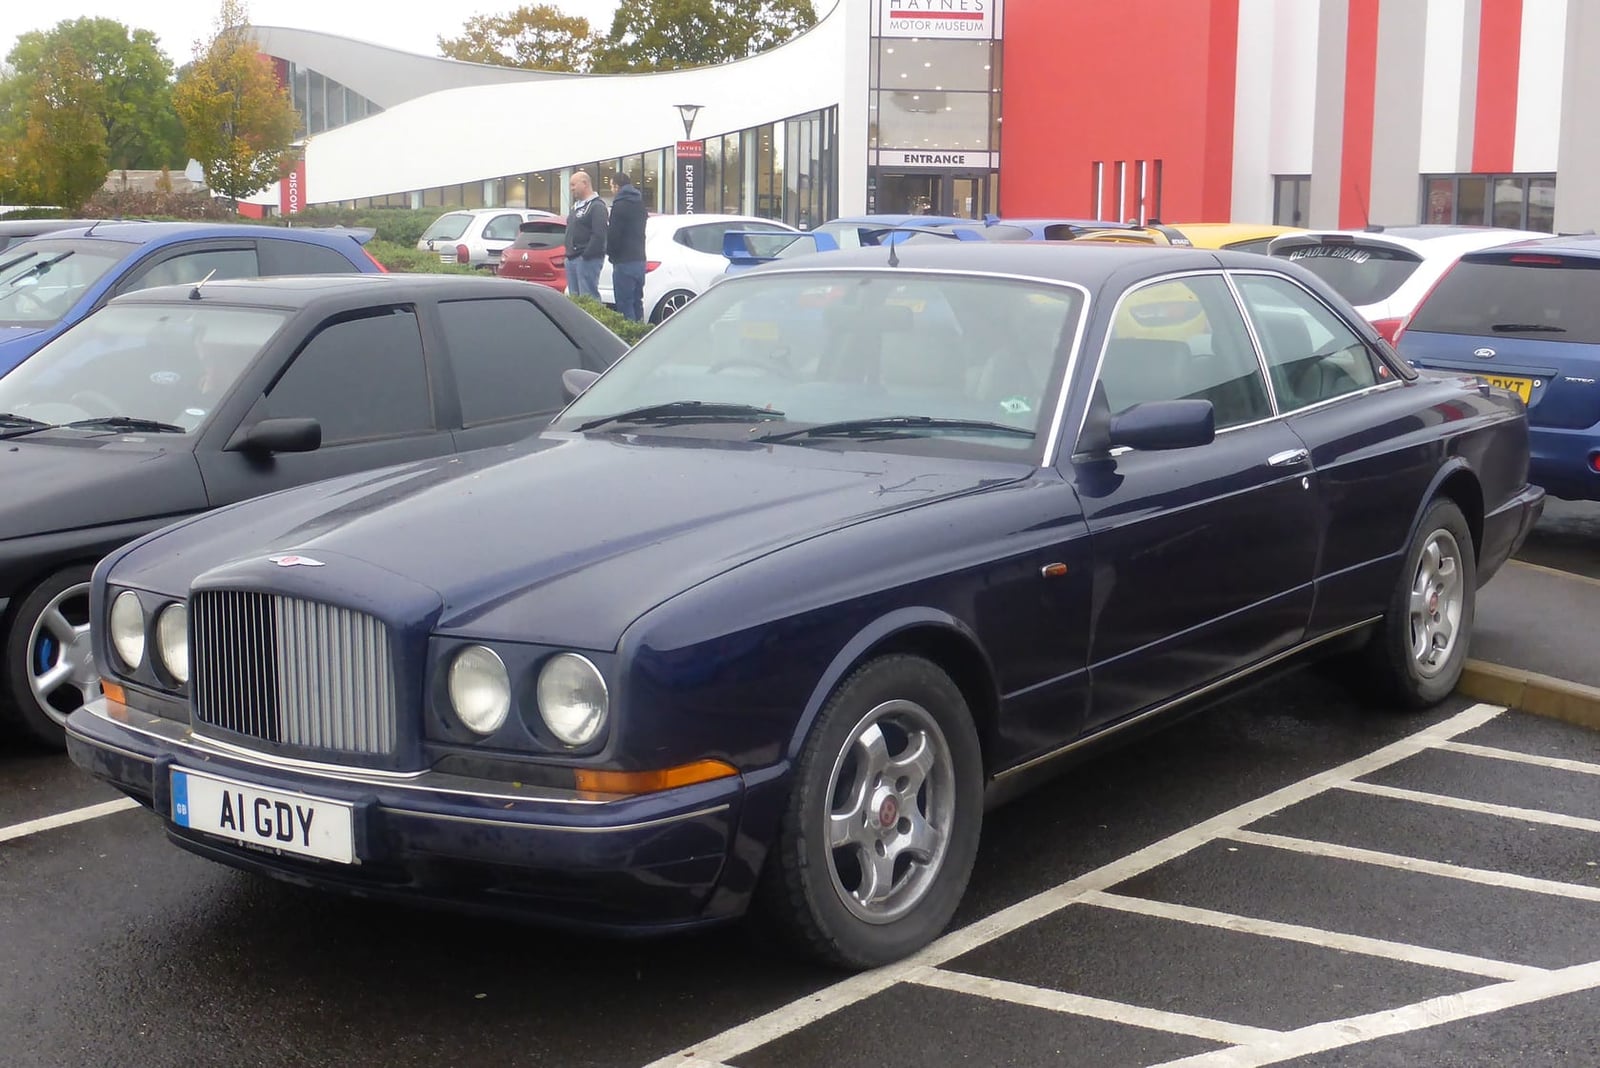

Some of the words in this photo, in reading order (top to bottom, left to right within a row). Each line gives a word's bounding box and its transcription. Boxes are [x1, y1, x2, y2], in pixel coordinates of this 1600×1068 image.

[890, 0, 984, 11] HAYNES
[889, 20, 931, 30] MOTOR
[934, 21, 984, 31] MUSEUM
[904, 154, 965, 164] ENTRANCE
[1289, 246, 1330, 260] DEADLY
[1331, 246, 1371, 264] BRAND
[176, 804, 187, 815] GB
[254, 797, 315, 847] GDY
